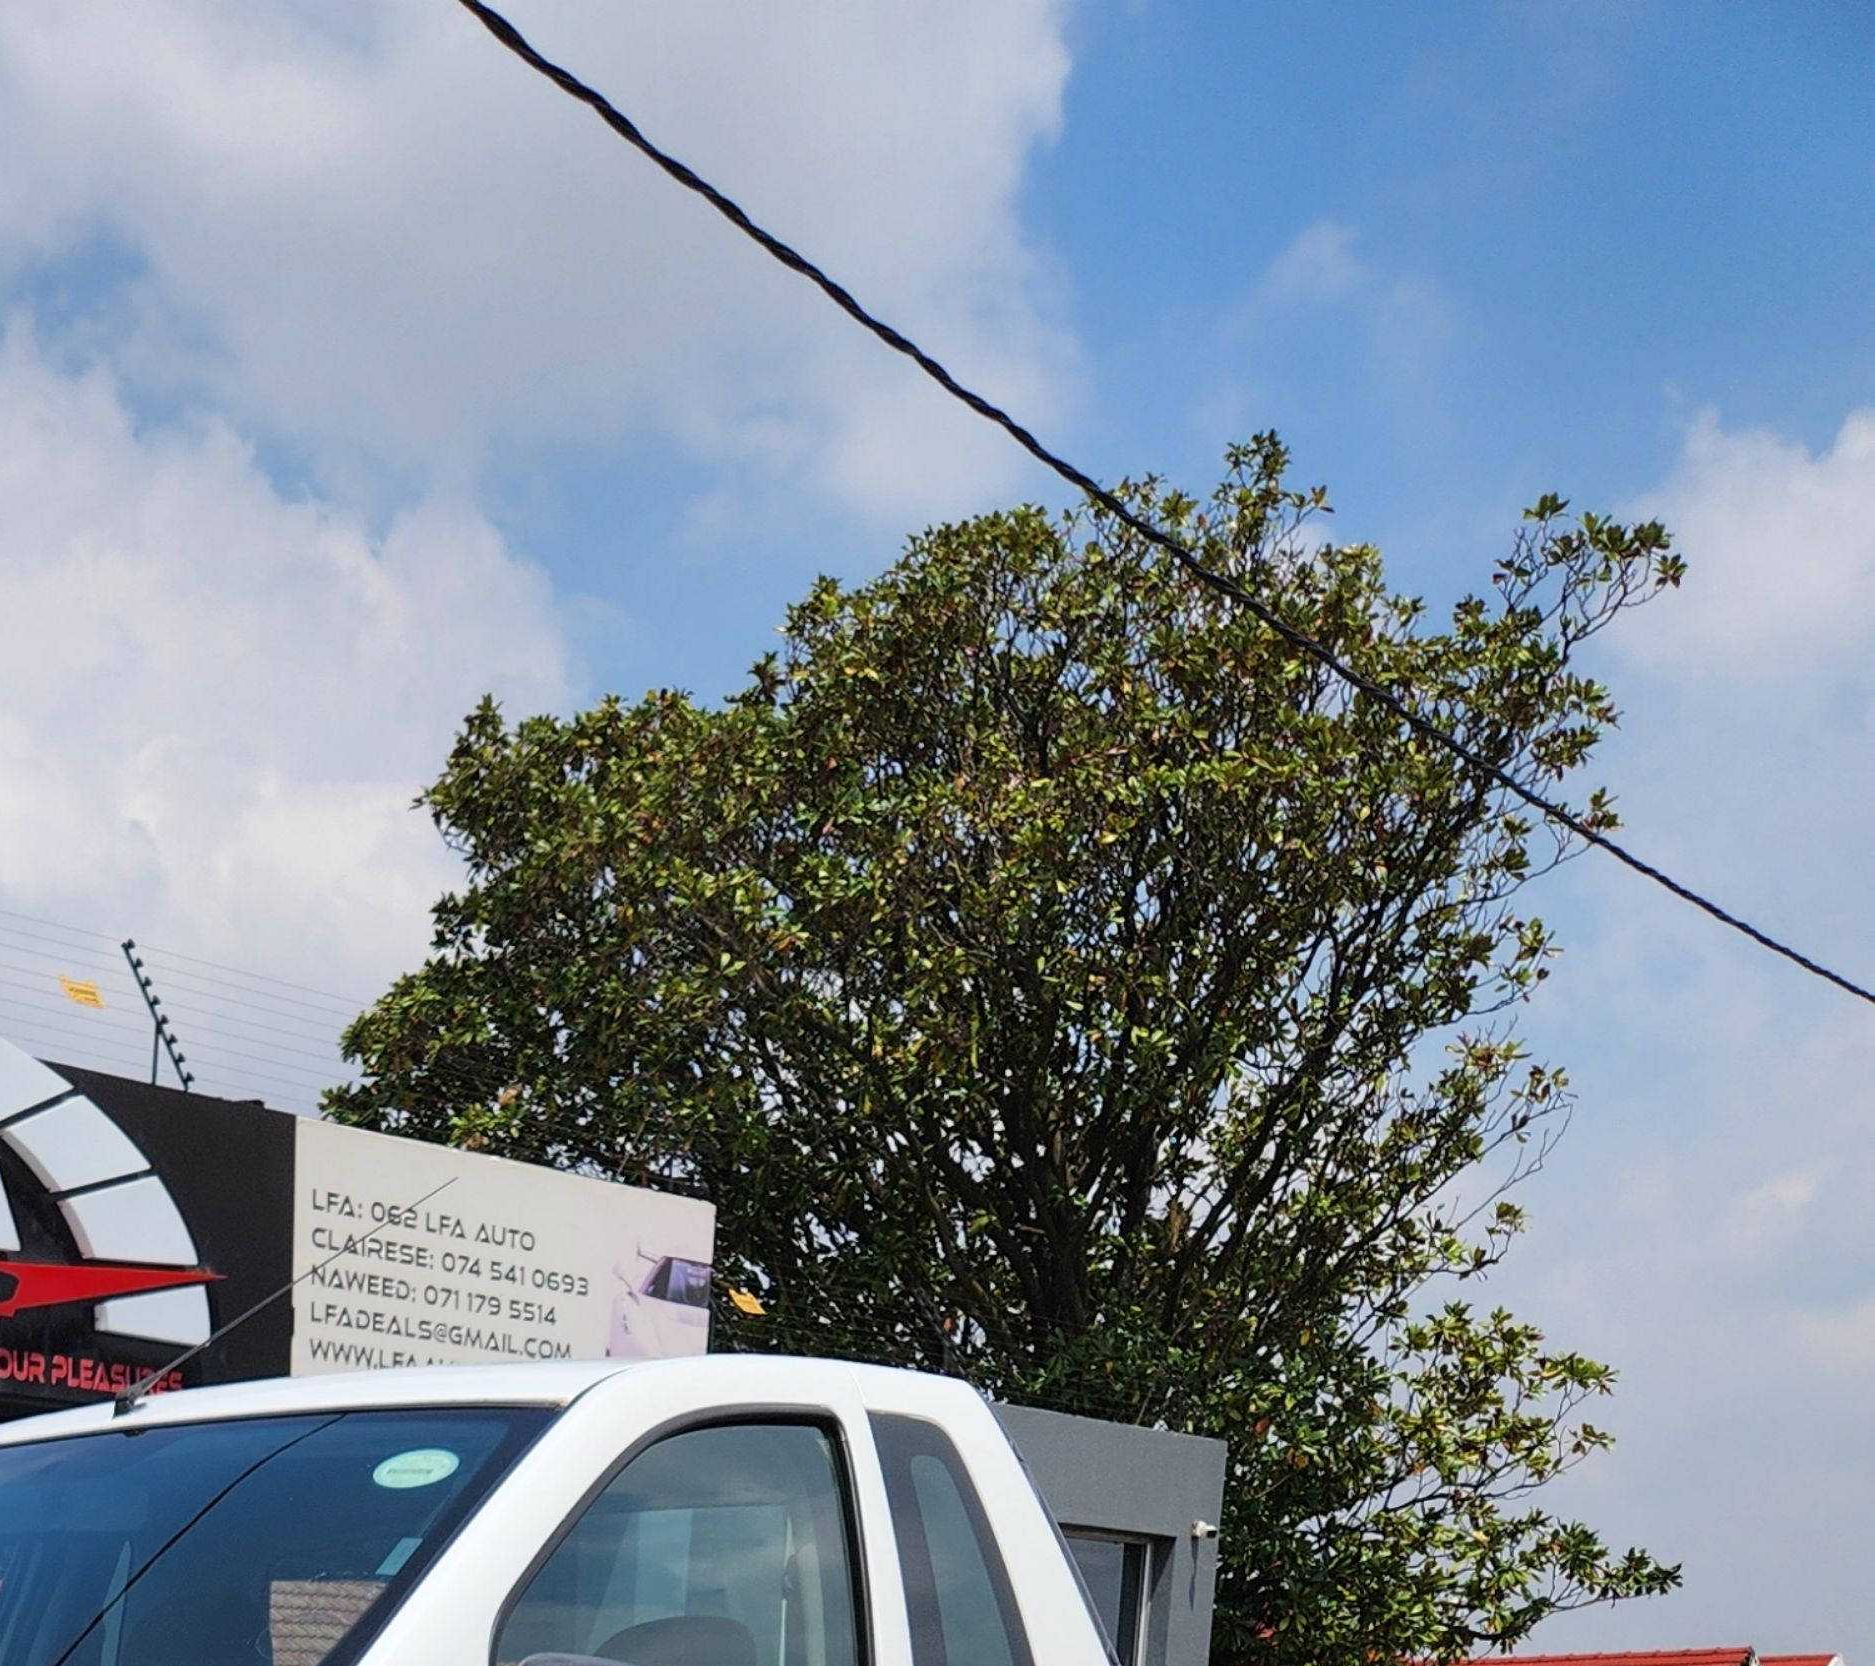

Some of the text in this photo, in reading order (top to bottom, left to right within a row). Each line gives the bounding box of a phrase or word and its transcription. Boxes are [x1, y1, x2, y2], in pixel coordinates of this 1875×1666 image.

[311, 1188, 536, 1251] LFA: 062 LFA AUTO
[311, 1227, 590, 1296] CLAIRESE: 074 541 0693
[311, 1264, 557, 1326] NAWEED: 071 179 5514
[310, 1302, 572, 1360] LFADEALS@GMAIL.COM
